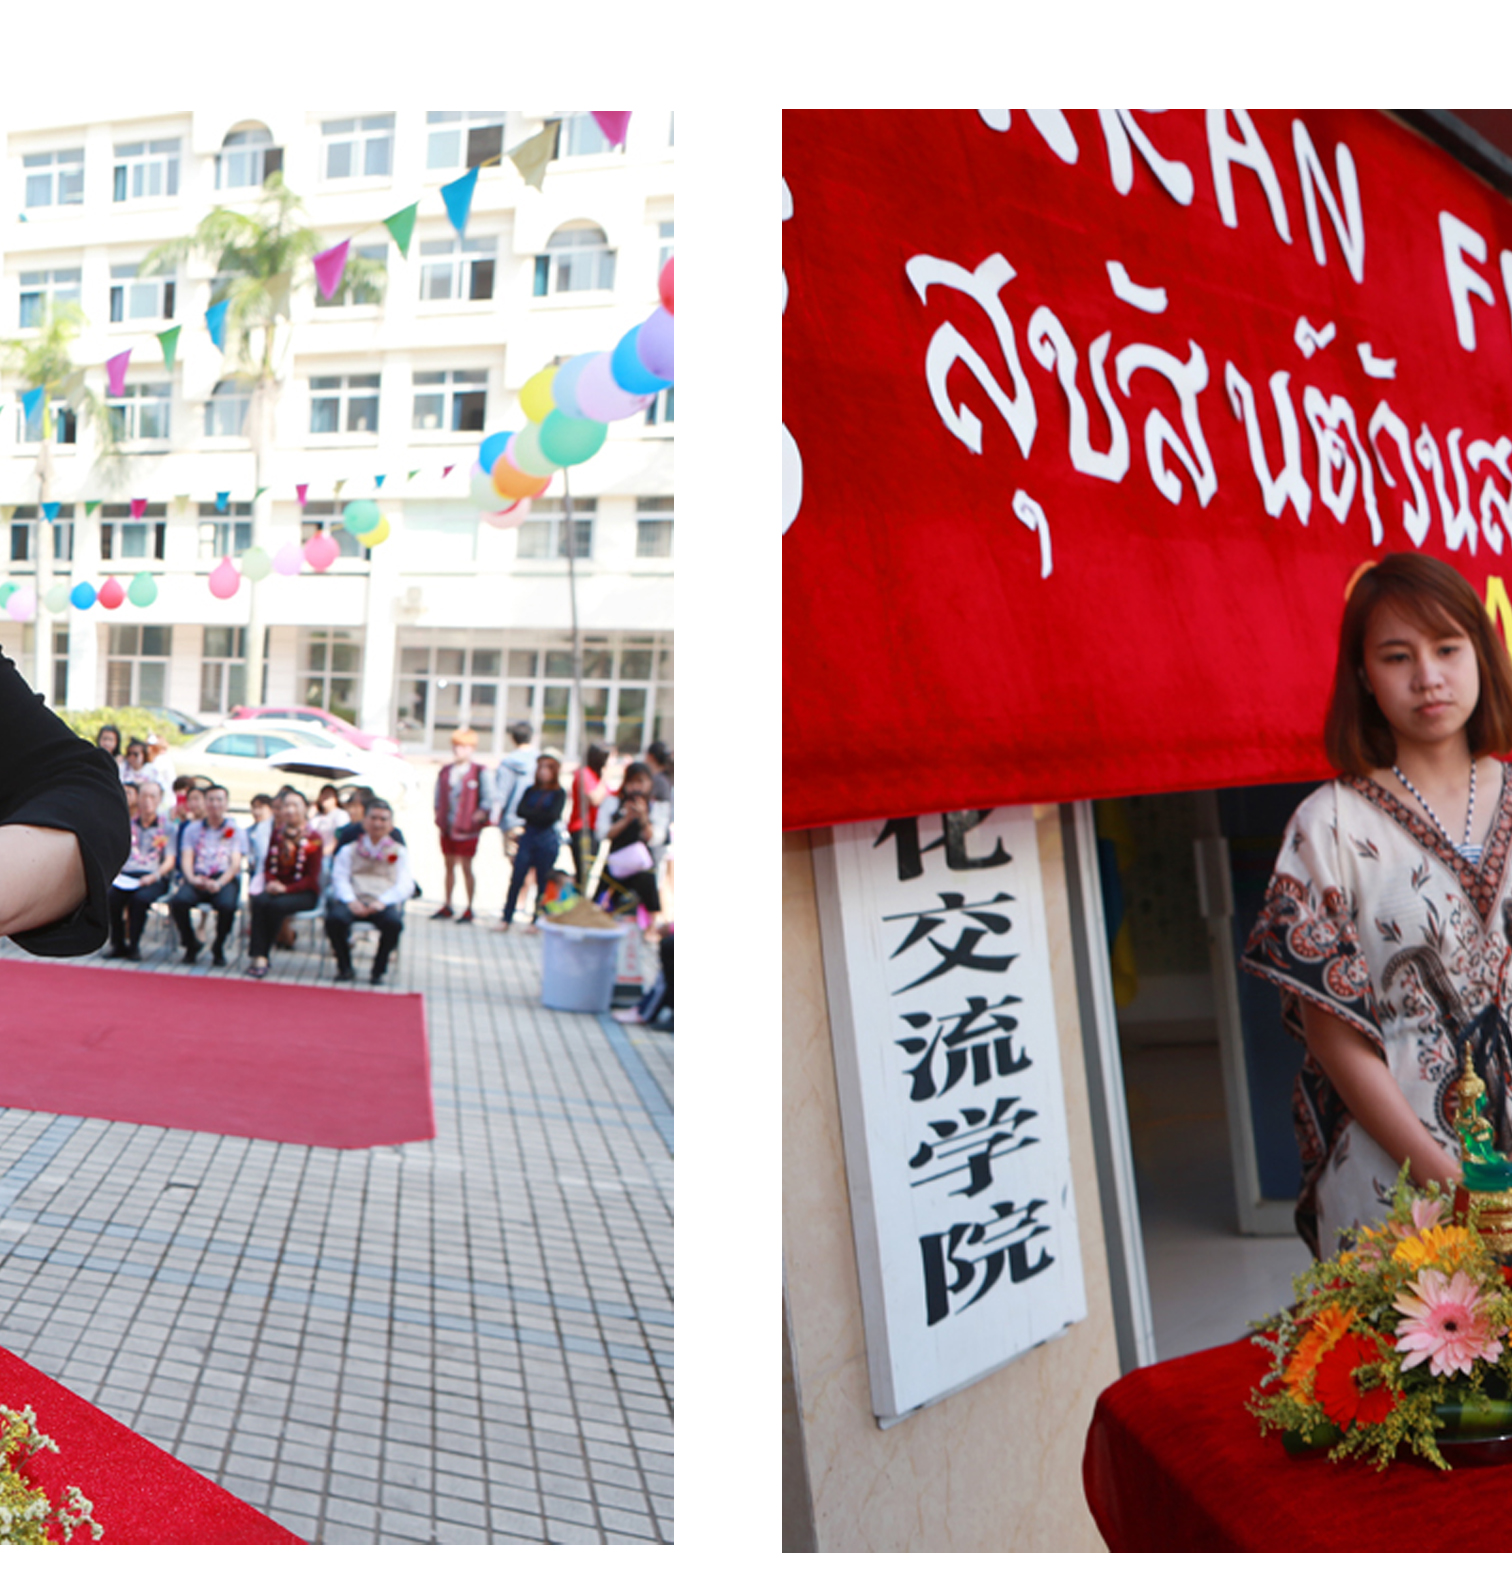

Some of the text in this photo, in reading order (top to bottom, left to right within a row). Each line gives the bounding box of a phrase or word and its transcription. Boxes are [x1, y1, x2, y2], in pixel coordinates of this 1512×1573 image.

[872, 806, 1055, 1328] 化交流学院
